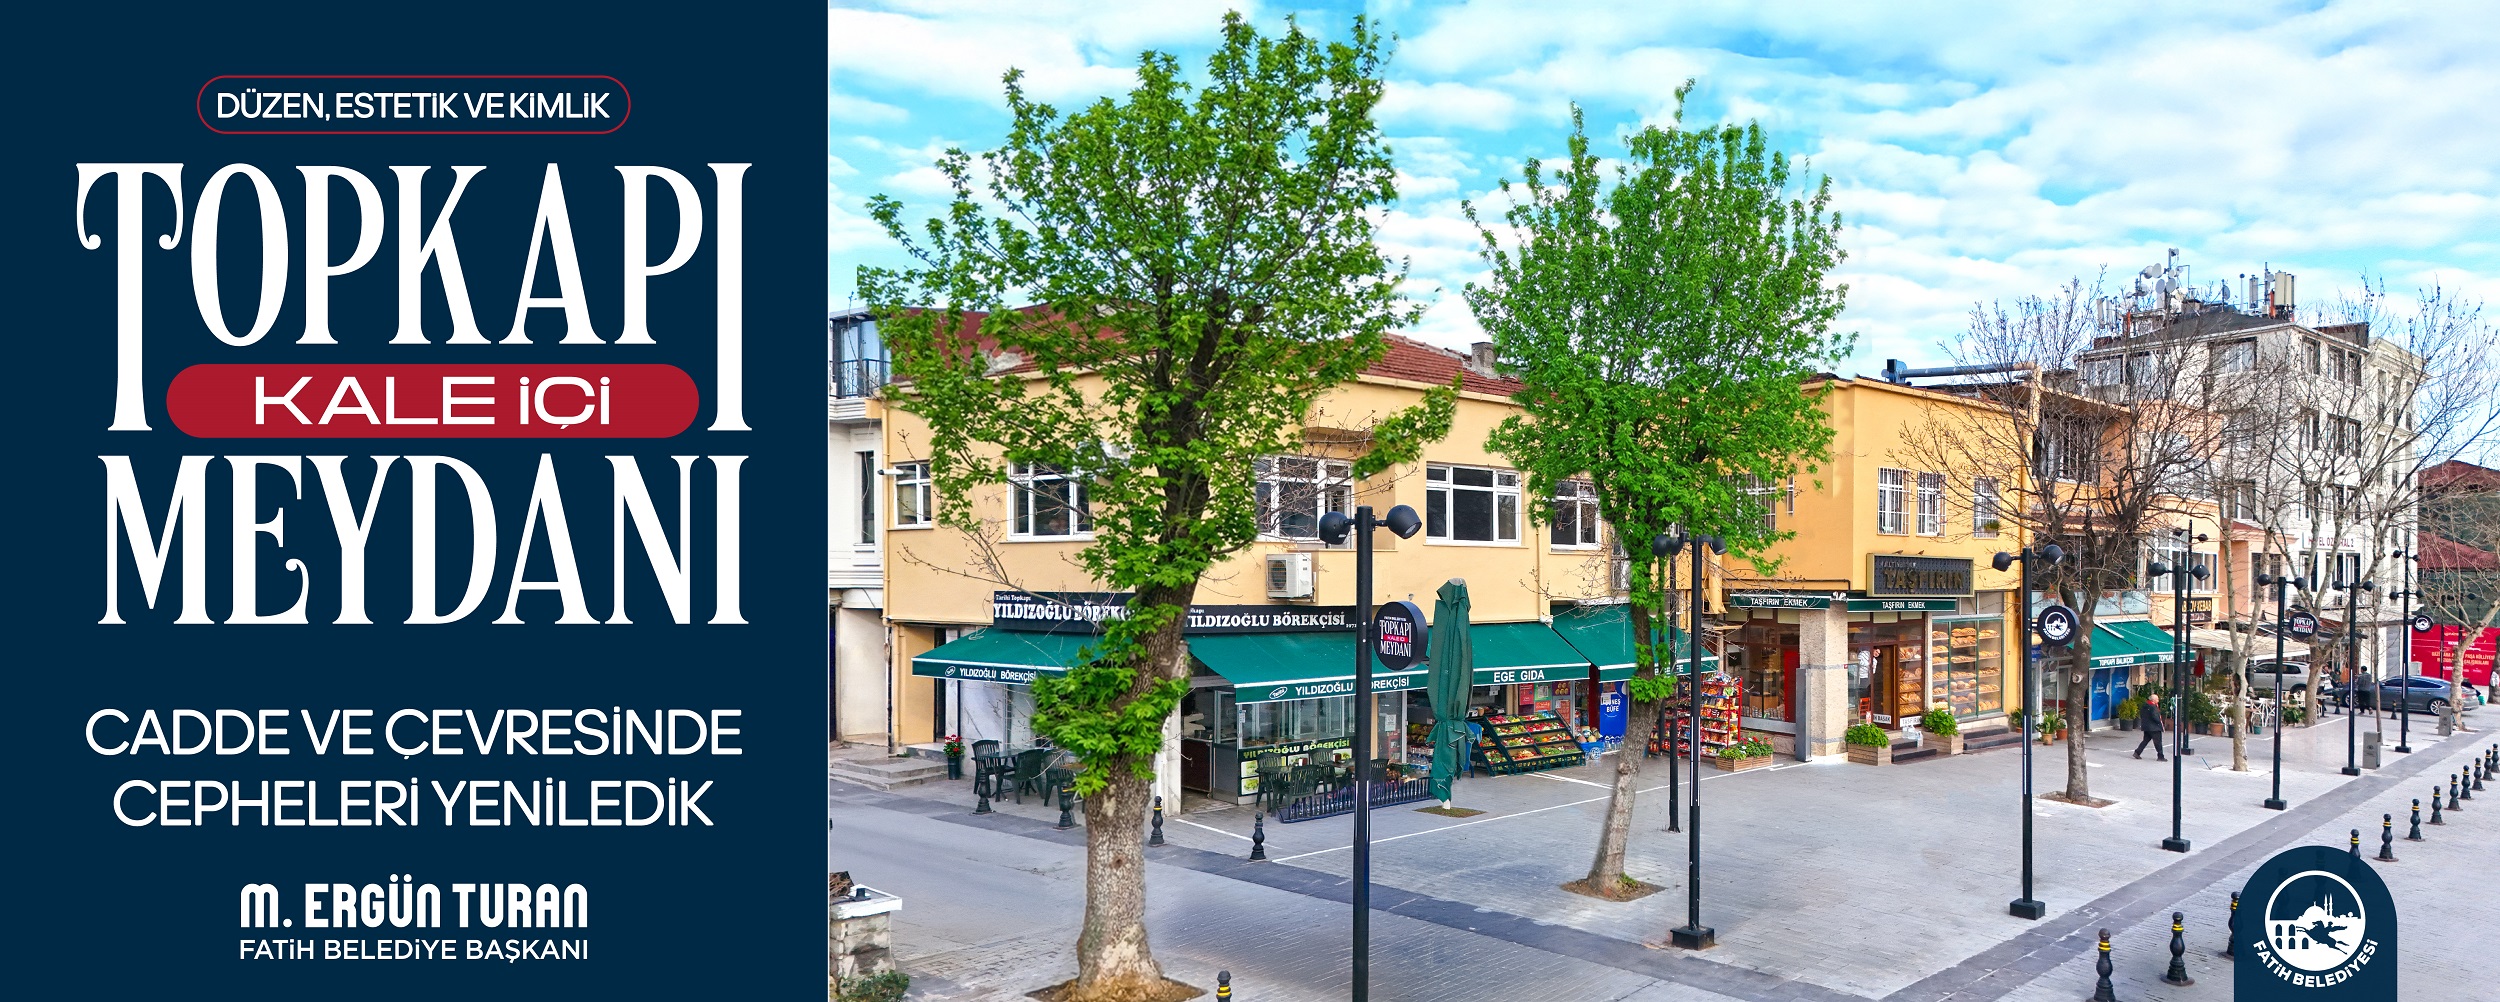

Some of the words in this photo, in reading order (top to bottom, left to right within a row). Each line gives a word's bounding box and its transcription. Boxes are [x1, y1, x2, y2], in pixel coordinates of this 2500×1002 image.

[993, 601, 1072, 620] YILDIZOĞLU
[1784, 597, 1809, 607] EKMEK
[1882, 601, 1905, 611] TAŞFIRIN
[1908, 601, 1926, 609] EKMEK
[1273, 611, 1345, 628] BÖREKÇİSİ
[1379, 619, 1412, 644] TOPKAPI
[1380, 640, 1412, 658] MEYDANI
[960, 667, 997, 679] YILDIZOĞLU
[1493, 670, 1516, 683] EGE
[1520, 669, 1546, 681] GIDA
[1295, 682, 1354, 696] YILDIZOĞLU
[1371, 676, 1410, 690] REKÇİSİ
